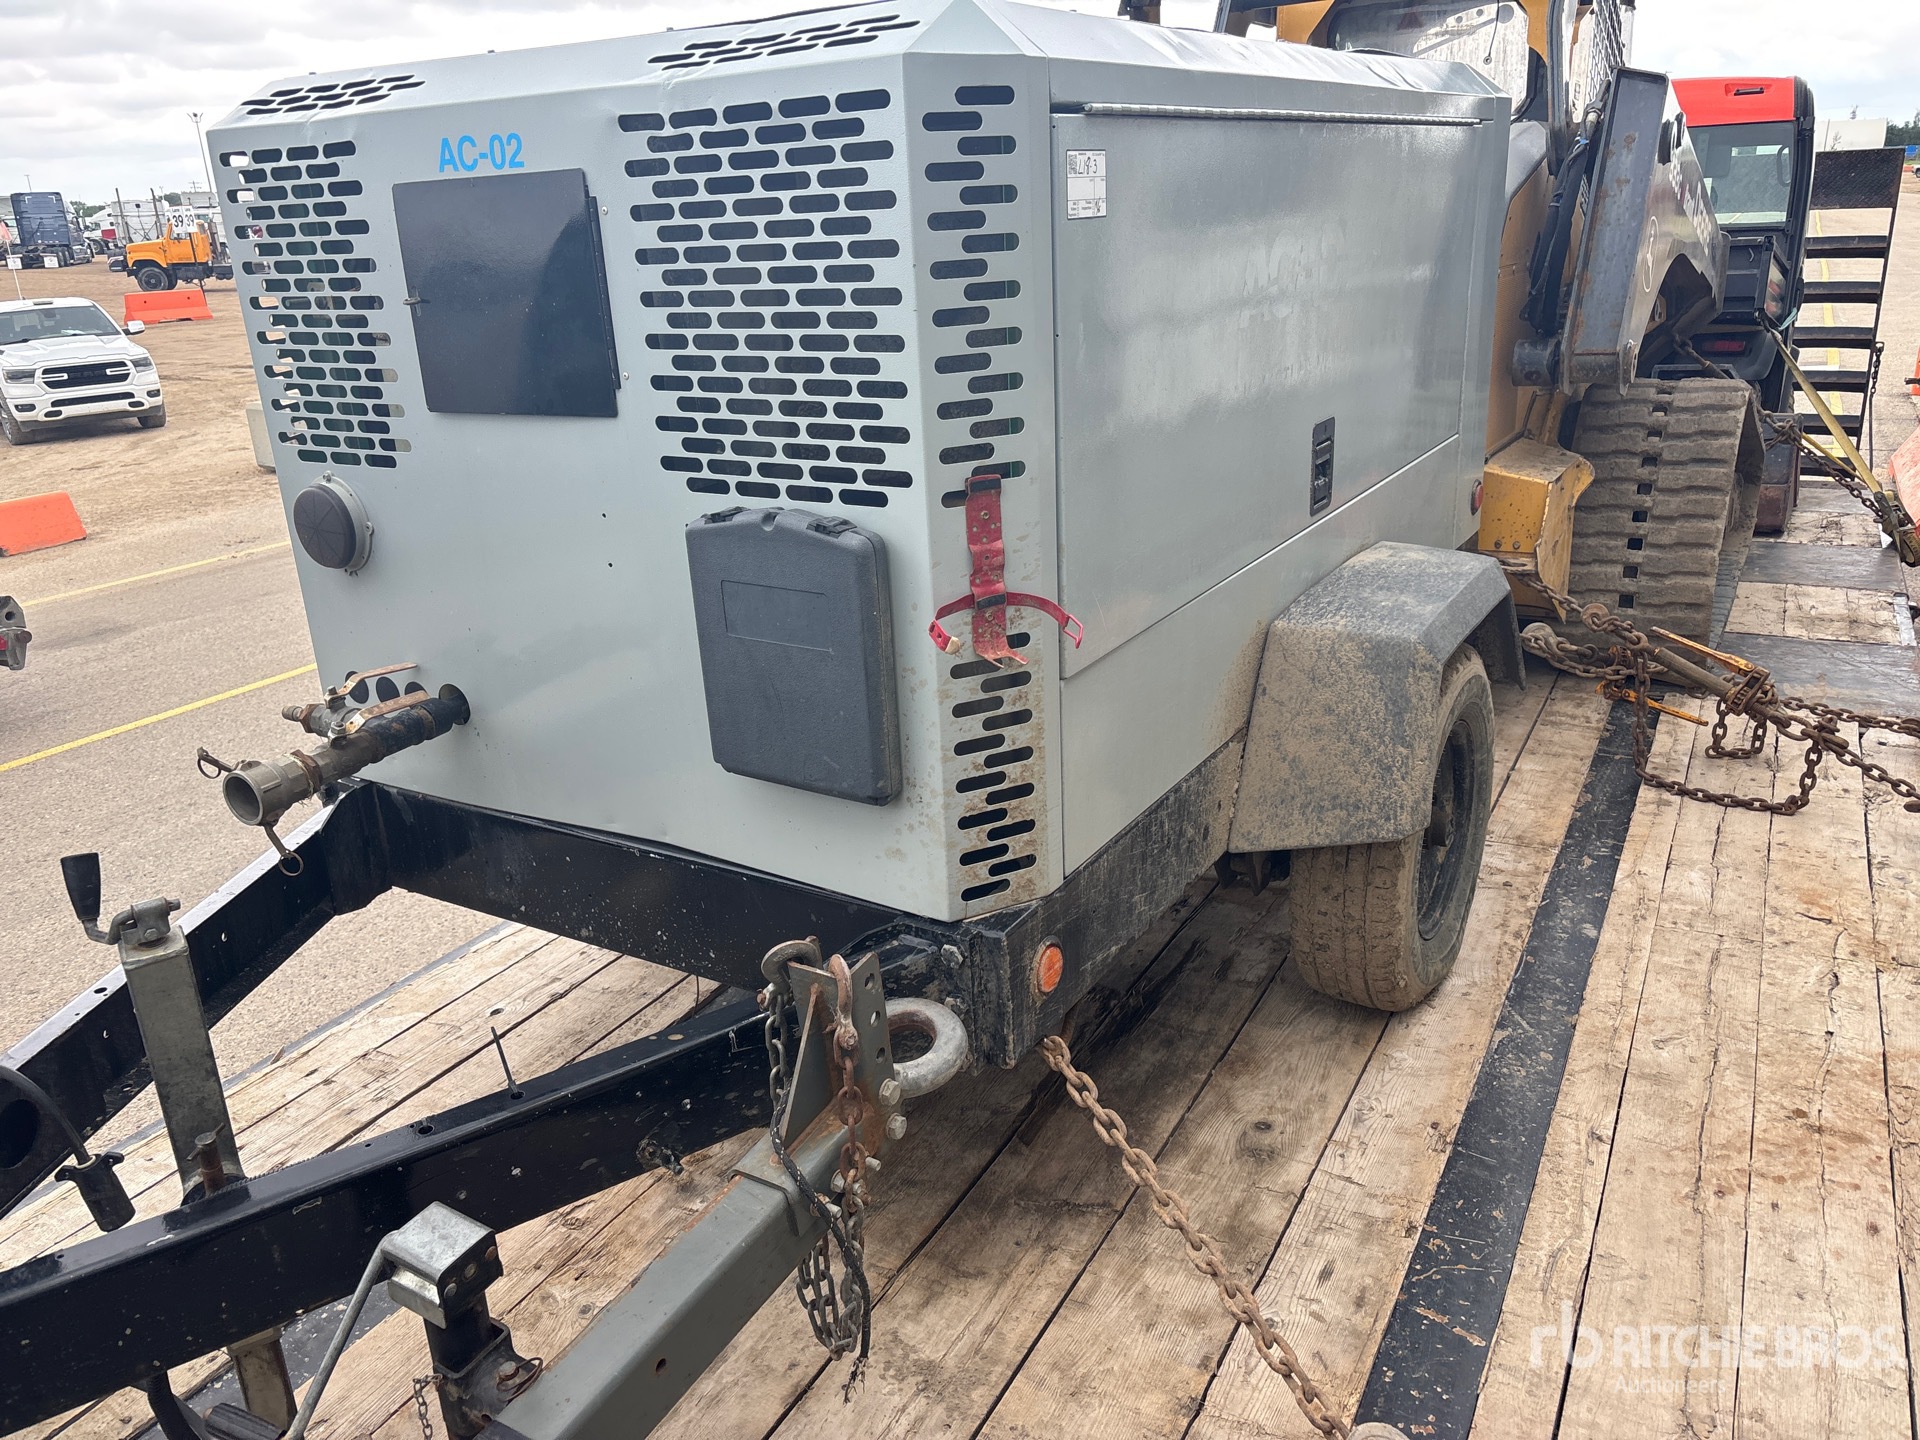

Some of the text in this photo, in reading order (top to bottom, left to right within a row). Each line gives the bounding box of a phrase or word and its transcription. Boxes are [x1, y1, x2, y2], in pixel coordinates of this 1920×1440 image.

[439, 132, 525, 172] AC-02
[172, 215, 184, 228] 39
[185, 214, 194, 227] 39
